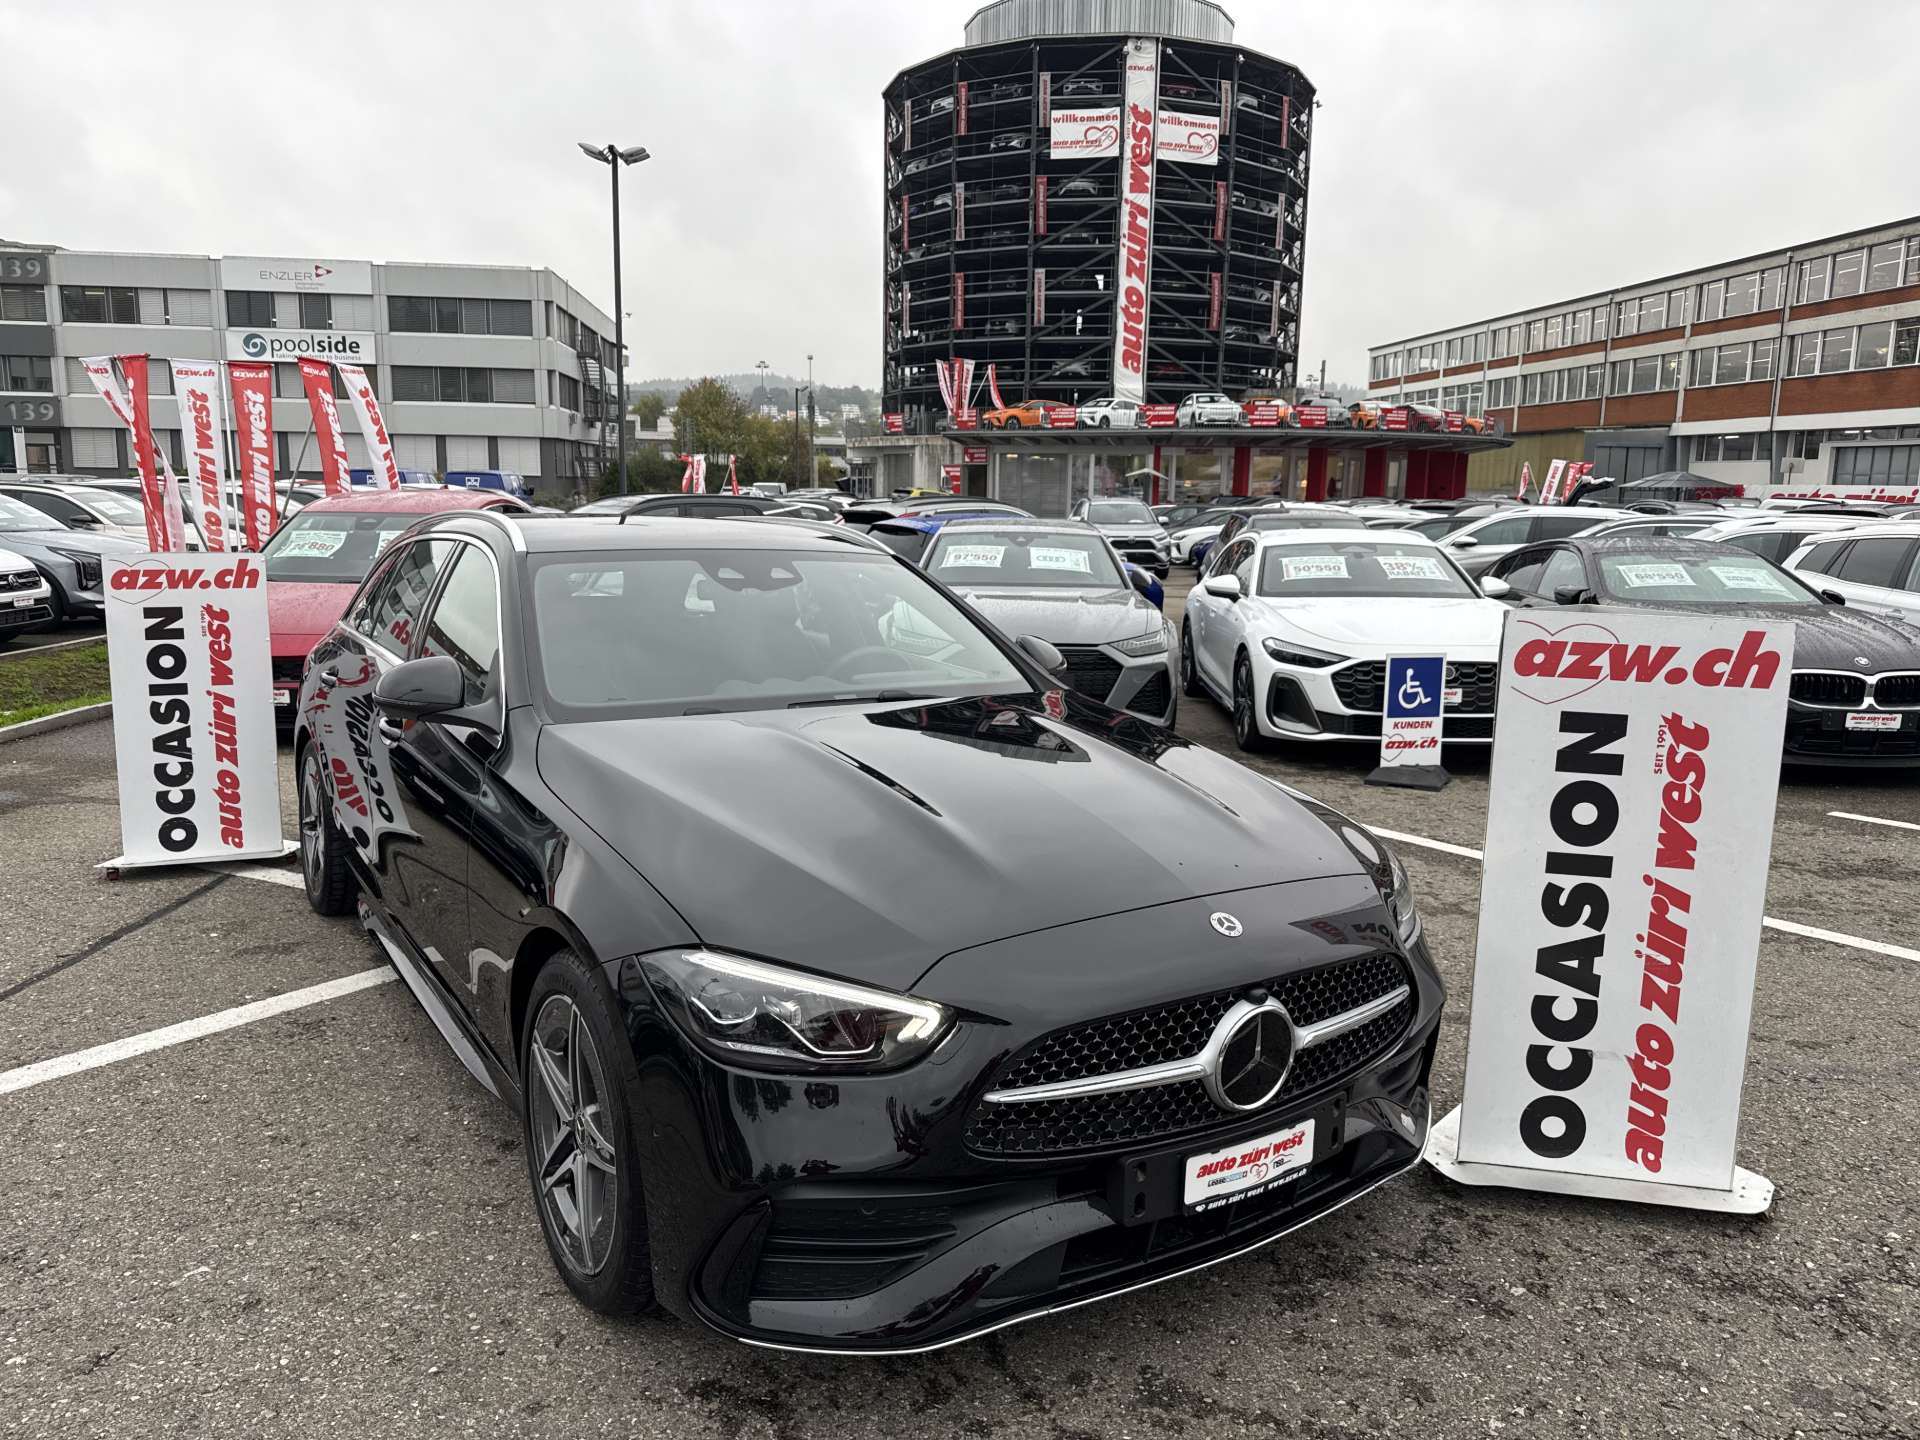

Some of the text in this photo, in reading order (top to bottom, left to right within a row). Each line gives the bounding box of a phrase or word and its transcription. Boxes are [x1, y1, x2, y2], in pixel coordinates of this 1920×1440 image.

[1053, 114, 1118, 123] willkommen
[1160, 116, 1217, 129] willkommen
[1120, 103, 1152, 375] auto züri west
[259, 271, 312, 281] ENZLER
[271, 335, 360, 358] poolside
[176, 369, 215, 377] azw.ch
[232, 370, 269, 378] azw.ch
[6, 403, 54, 421] 139
[244, 389, 268, 448] west
[187, 388, 224, 552] uto züri west
[248, 450, 272, 508] züri
[110, 559, 260, 591] azw.ch
[1513, 630, 1781, 690] azw.ch
[143, 606, 199, 853] OCCASION
[201, 603, 244, 850] auto züri west
[1385, 736, 1438, 749] azw.ch
[1393, 721, 1432, 729] KUNDEN
[1654, 724, 1667, 775] SEIT 1991
[1519, 710, 1629, 1159] OCCASION
[1625, 712, 1710, 1175] auto züri west
[1196, 1155, 1237, 1178] auto
[1237, 1143, 1272, 1169] züri
[1273, 1130, 1305, 1156] west
[1208, 1199, 1227, 1209] auto
[1228, 1192, 1246, 1203] züri
[1247, 1186, 1264, 1197] west
